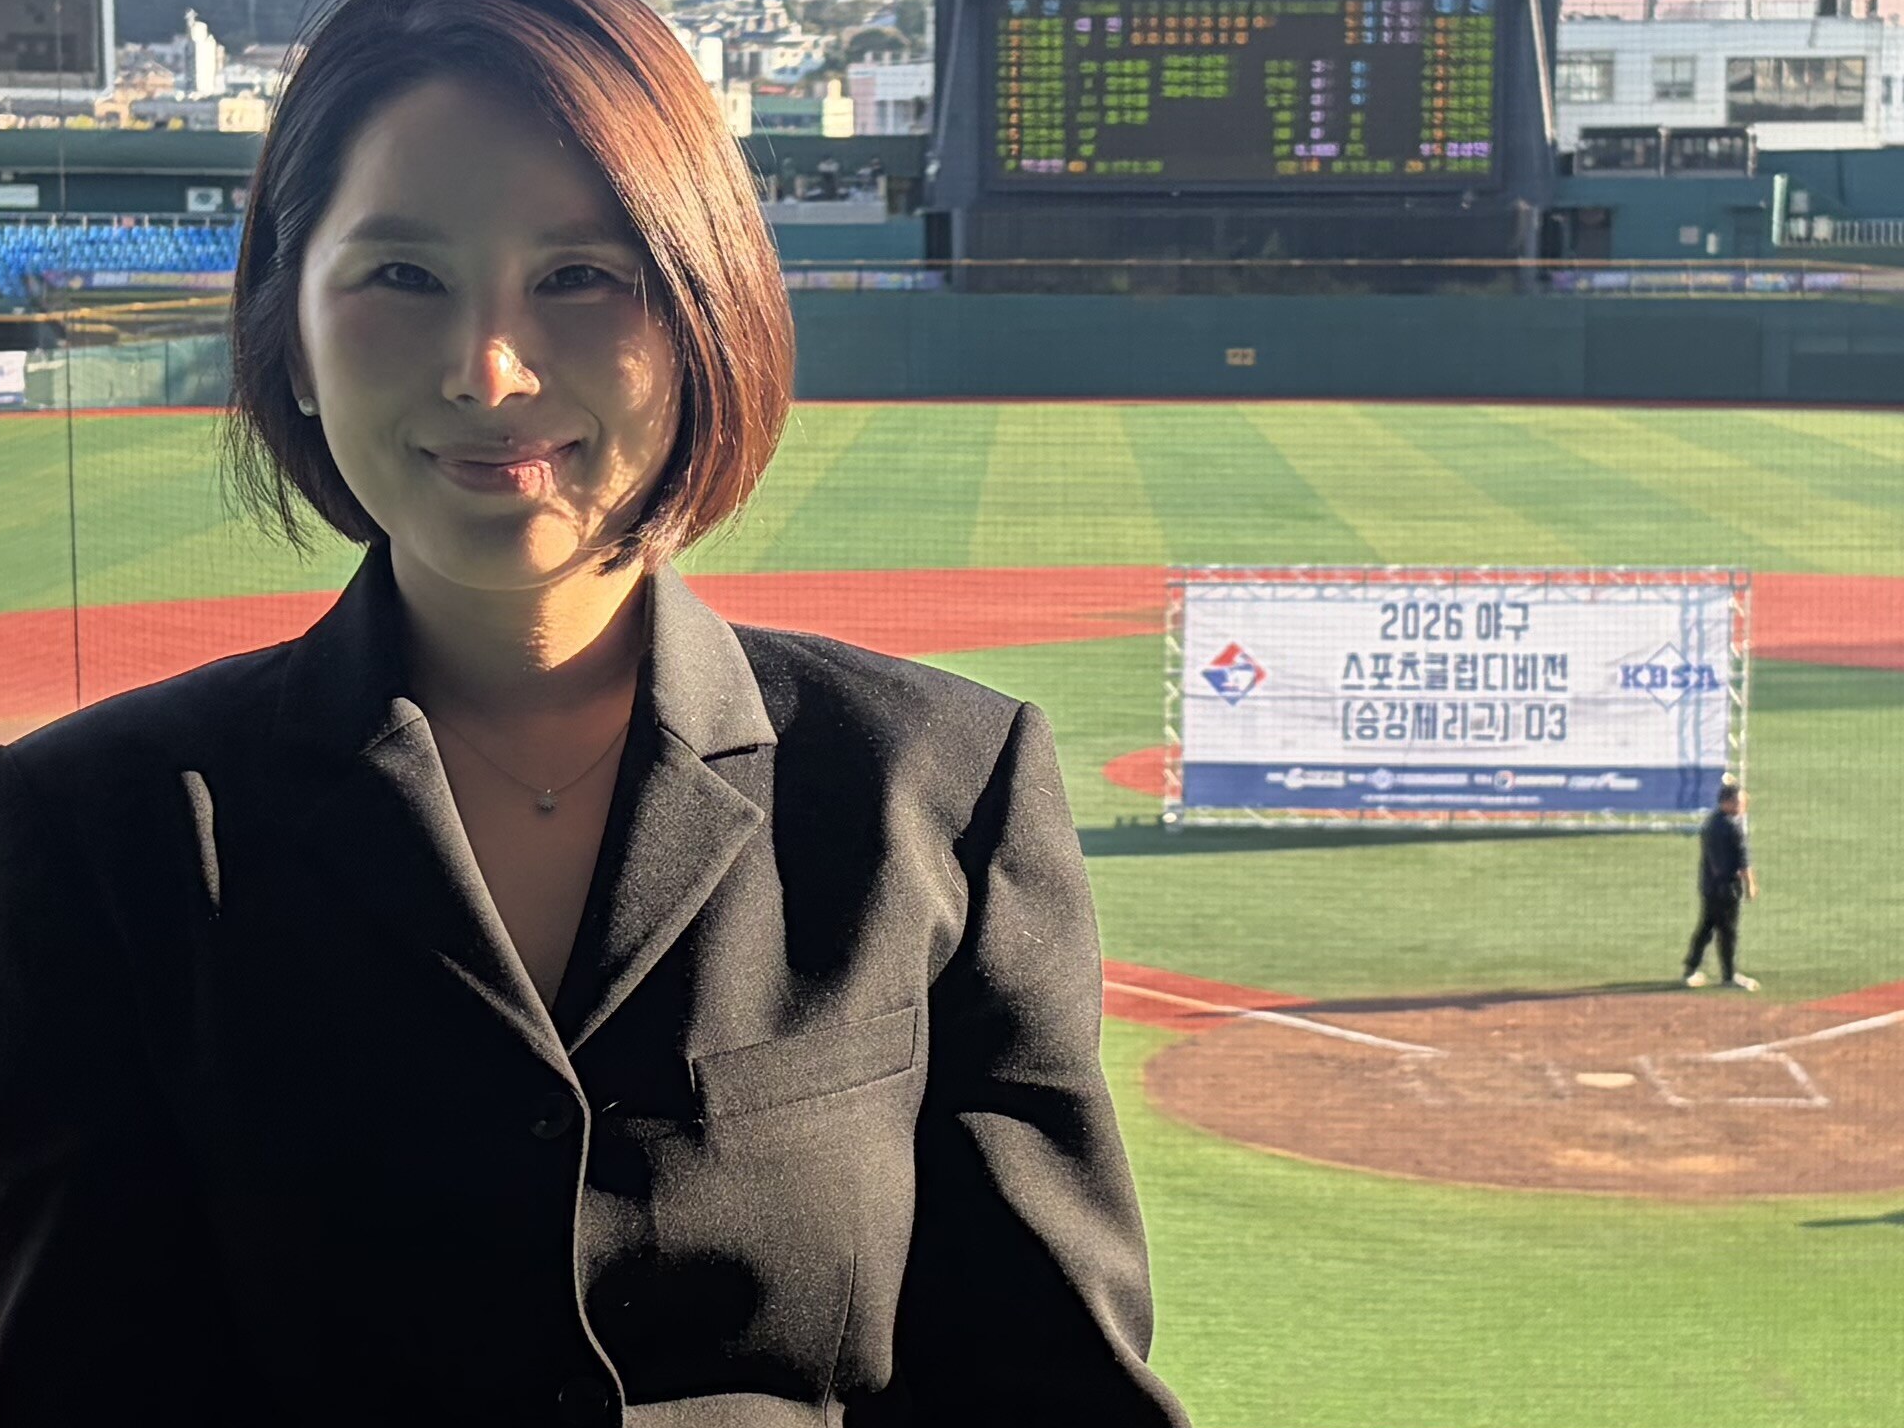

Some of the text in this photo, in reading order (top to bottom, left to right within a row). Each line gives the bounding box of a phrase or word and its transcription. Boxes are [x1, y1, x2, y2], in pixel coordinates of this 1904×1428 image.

[1380, 601, 1530, 641] 2026 야구
[1341, 652, 1569, 692] 스포츠클럽디비전
[1619, 663, 1720, 690] KBSA
[1342, 700, 1510, 742] (승강제리그)
